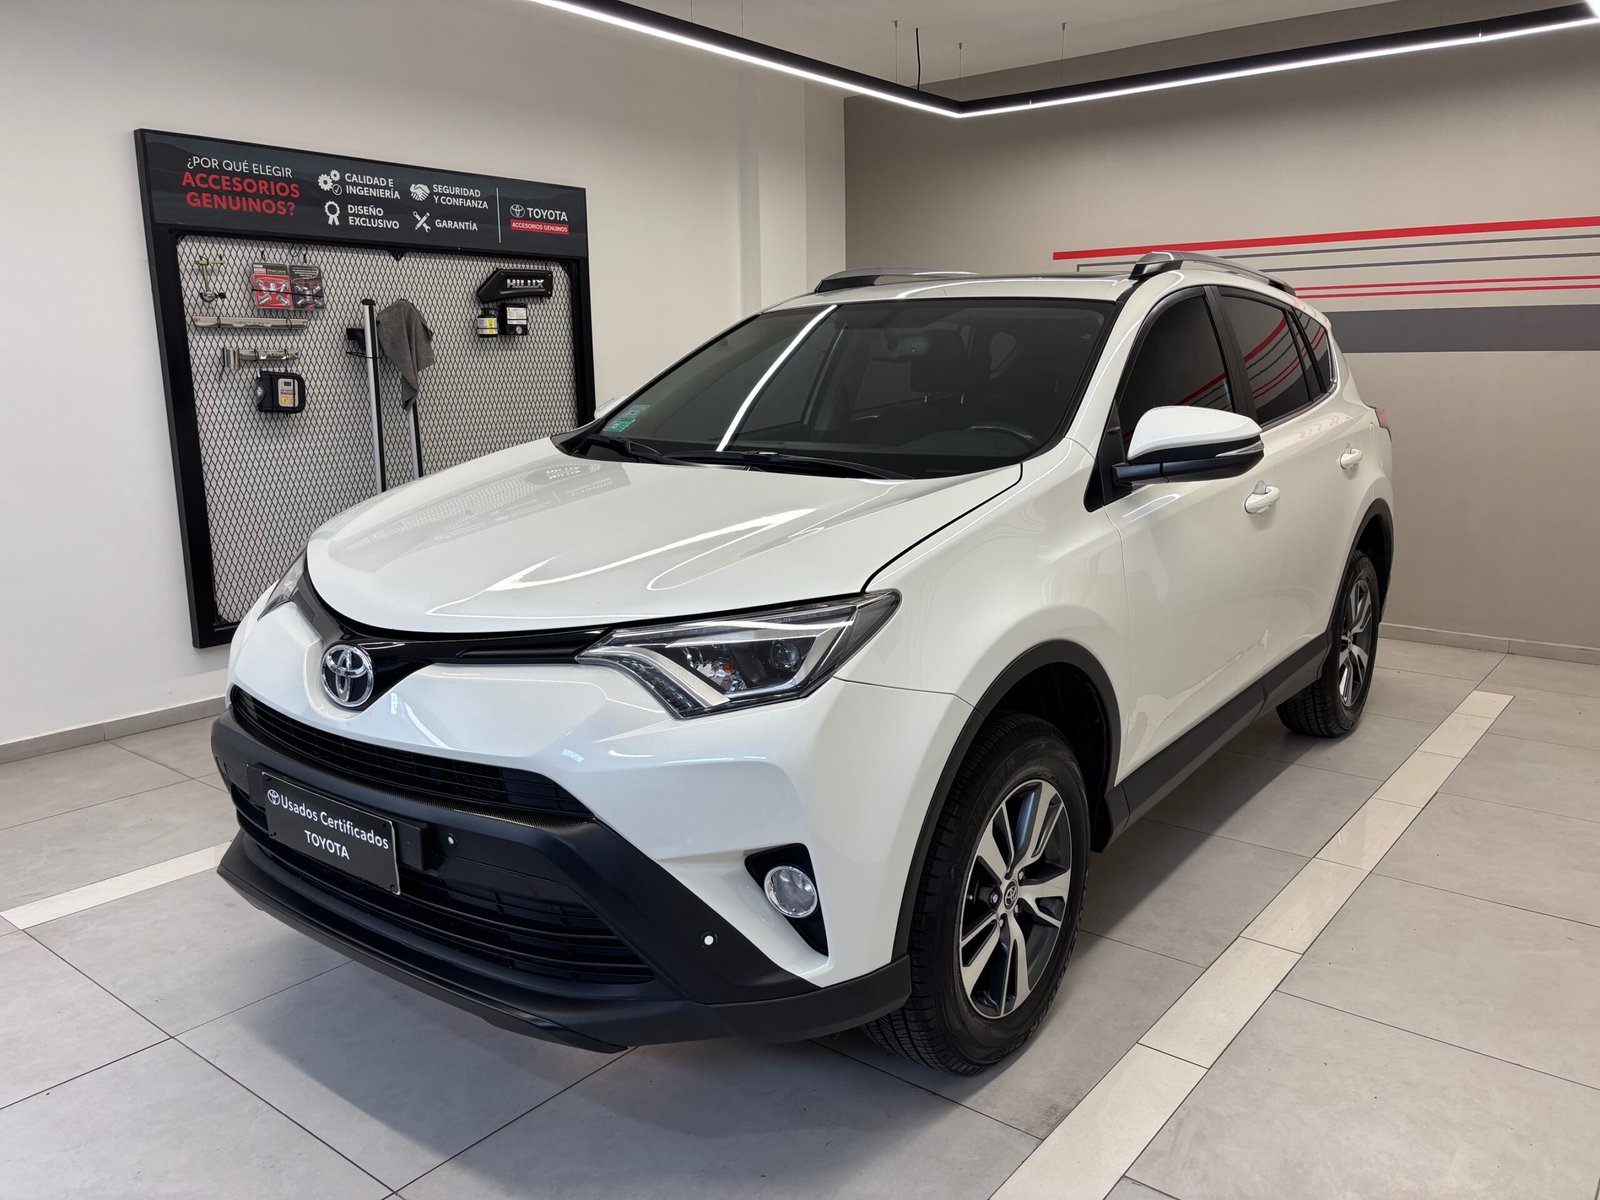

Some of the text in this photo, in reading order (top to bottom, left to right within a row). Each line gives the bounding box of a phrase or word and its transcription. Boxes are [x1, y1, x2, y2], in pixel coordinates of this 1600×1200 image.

[186, 156, 293, 179] ¿POR QUÉ ELEGIR
[182, 171, 300, 199] ACCESORIOS
[344, 173, 394, 188] CALIDAD E
[345, 185, 401, 200] INGENIERÍA
[432, 183, 481, 198] SEGURIDAD
[186, 191, 296, 217] GENUINOS?
[433, 195, 489, 210] Y CONFIANZA
[347, 204, 384, 217] DISEÑO
[526, 207, 568, 222] TOYOTA
[348, 216, 400, 230] EXCLUSIVO
[435, 219, 479, 232] GARANTÍA
[512, 221, 568, 233] ACCESORIOS GENUINOS
[506, 278, 545, 289] HILUX
[280, 794, 389, 850] Usados Certificados
[304, 829, 350, 860] TOYOTA
